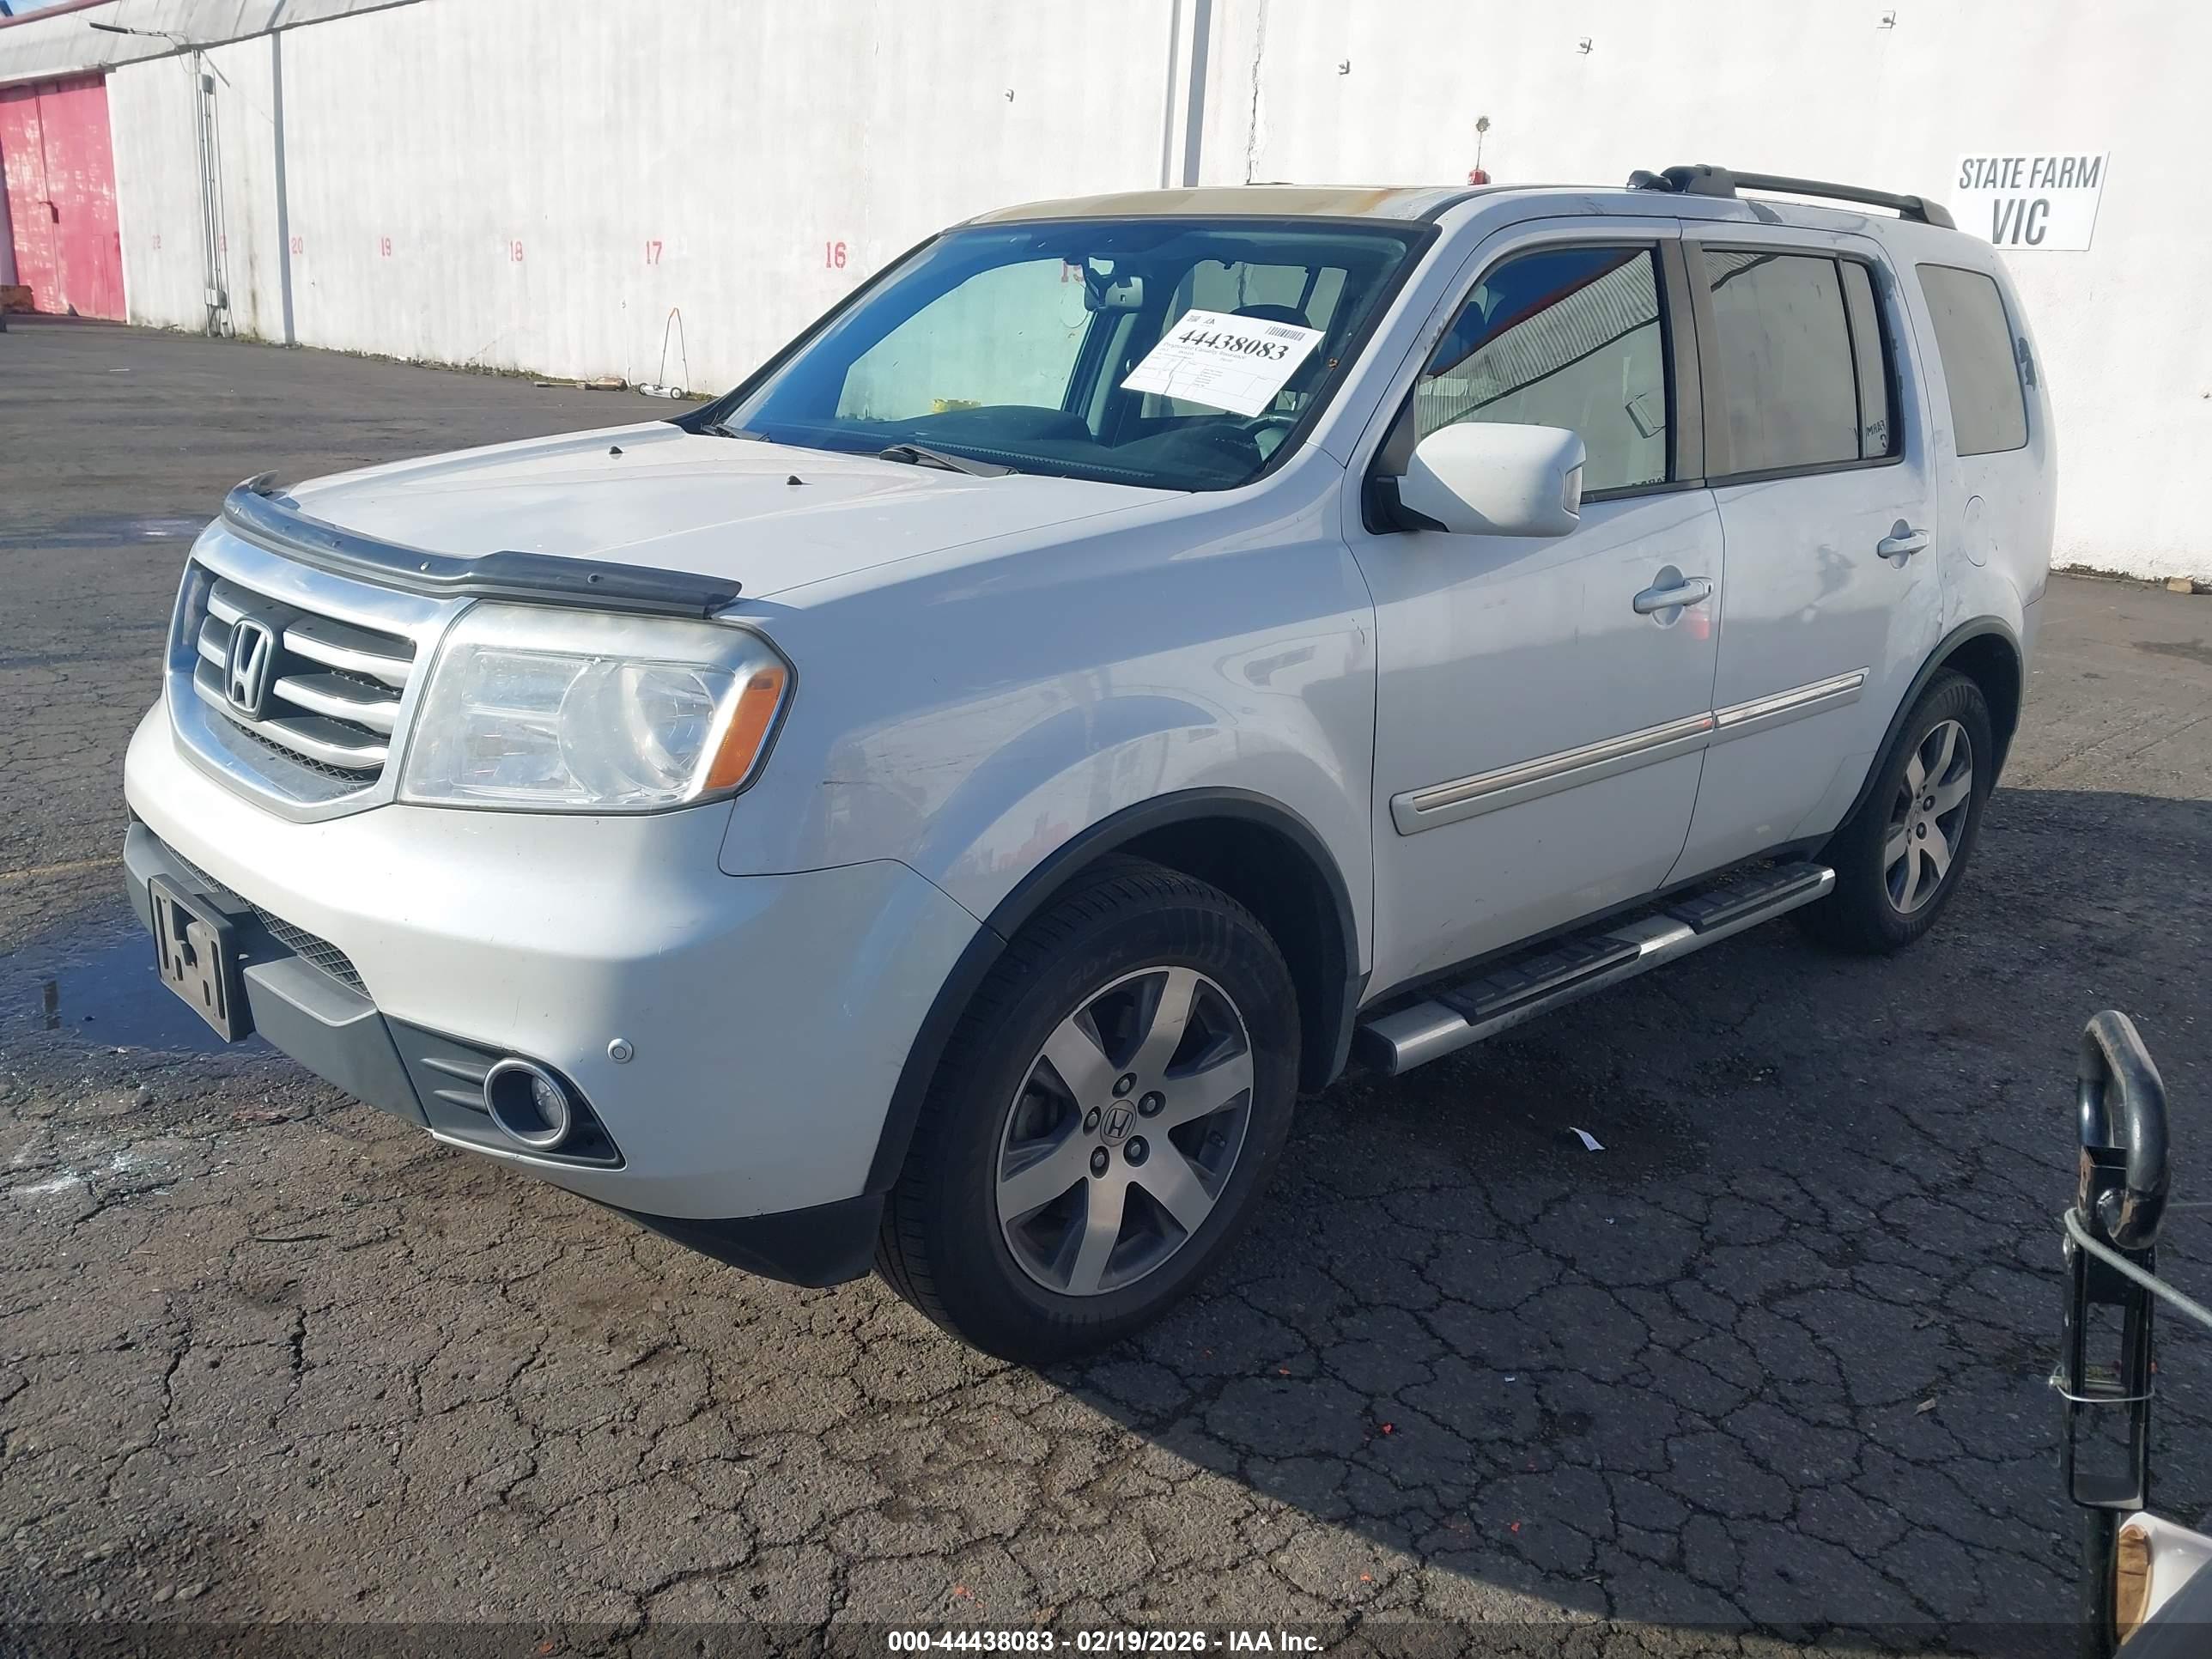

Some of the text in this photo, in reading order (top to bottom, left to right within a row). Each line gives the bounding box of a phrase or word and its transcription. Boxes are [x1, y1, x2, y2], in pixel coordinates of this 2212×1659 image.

[1959, 155, 2102, 190] STATE FARM
[1991, 198, 2051, 246] VIC
[291, 236, 303, 254] 20
[380, 237, 392, 257] 19
[510, 240, 523, 262] 18
[646, 240, 662, 265] 17
[825, 241, 847, 269] 16
[1178, 329, 1290, 361] 44438083
